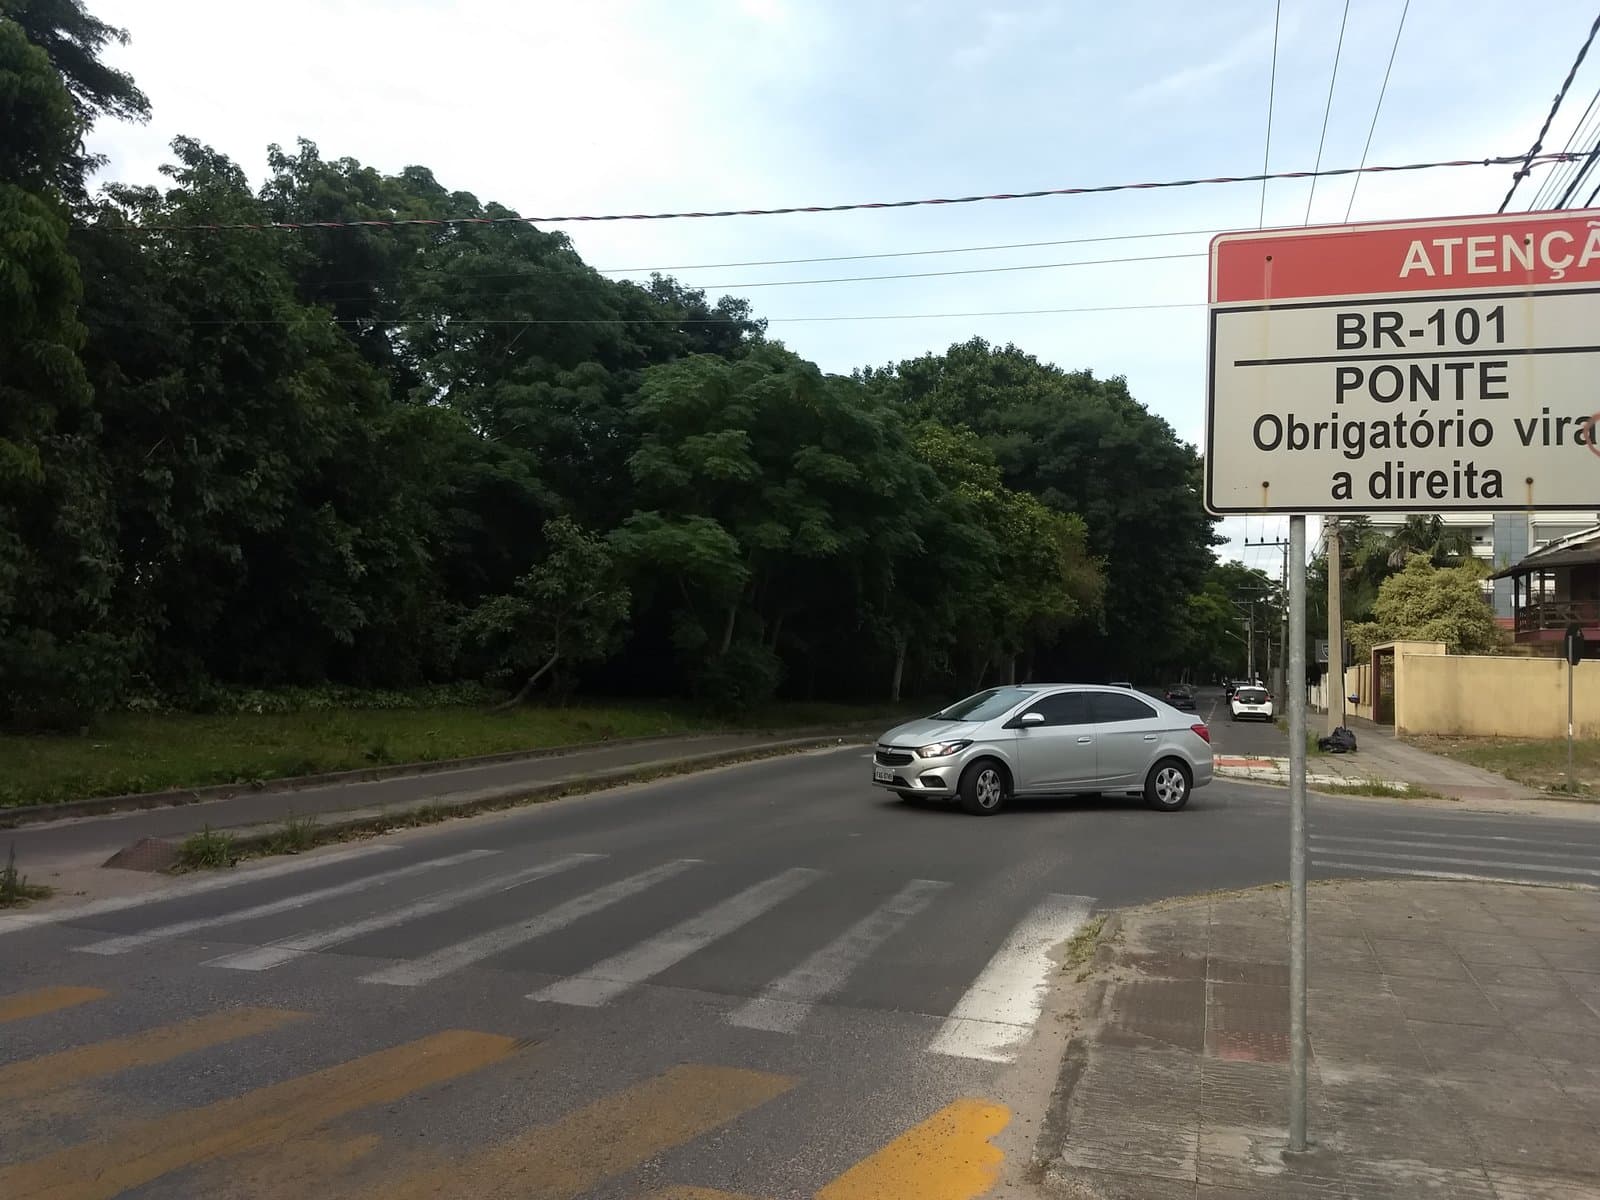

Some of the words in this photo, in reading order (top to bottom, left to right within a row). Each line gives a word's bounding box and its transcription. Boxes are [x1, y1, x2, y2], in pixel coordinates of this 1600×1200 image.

[1336, 305, 1505, 350] BR-101
[1336, 361, 1509, 404] PONTE
[1253, 409, 1494, 459] Obrigatório
[1513, 407, 1597, 447] vira
[1331, 469, 1353, 500] a
[1368, 460, 1503, 500] direita
